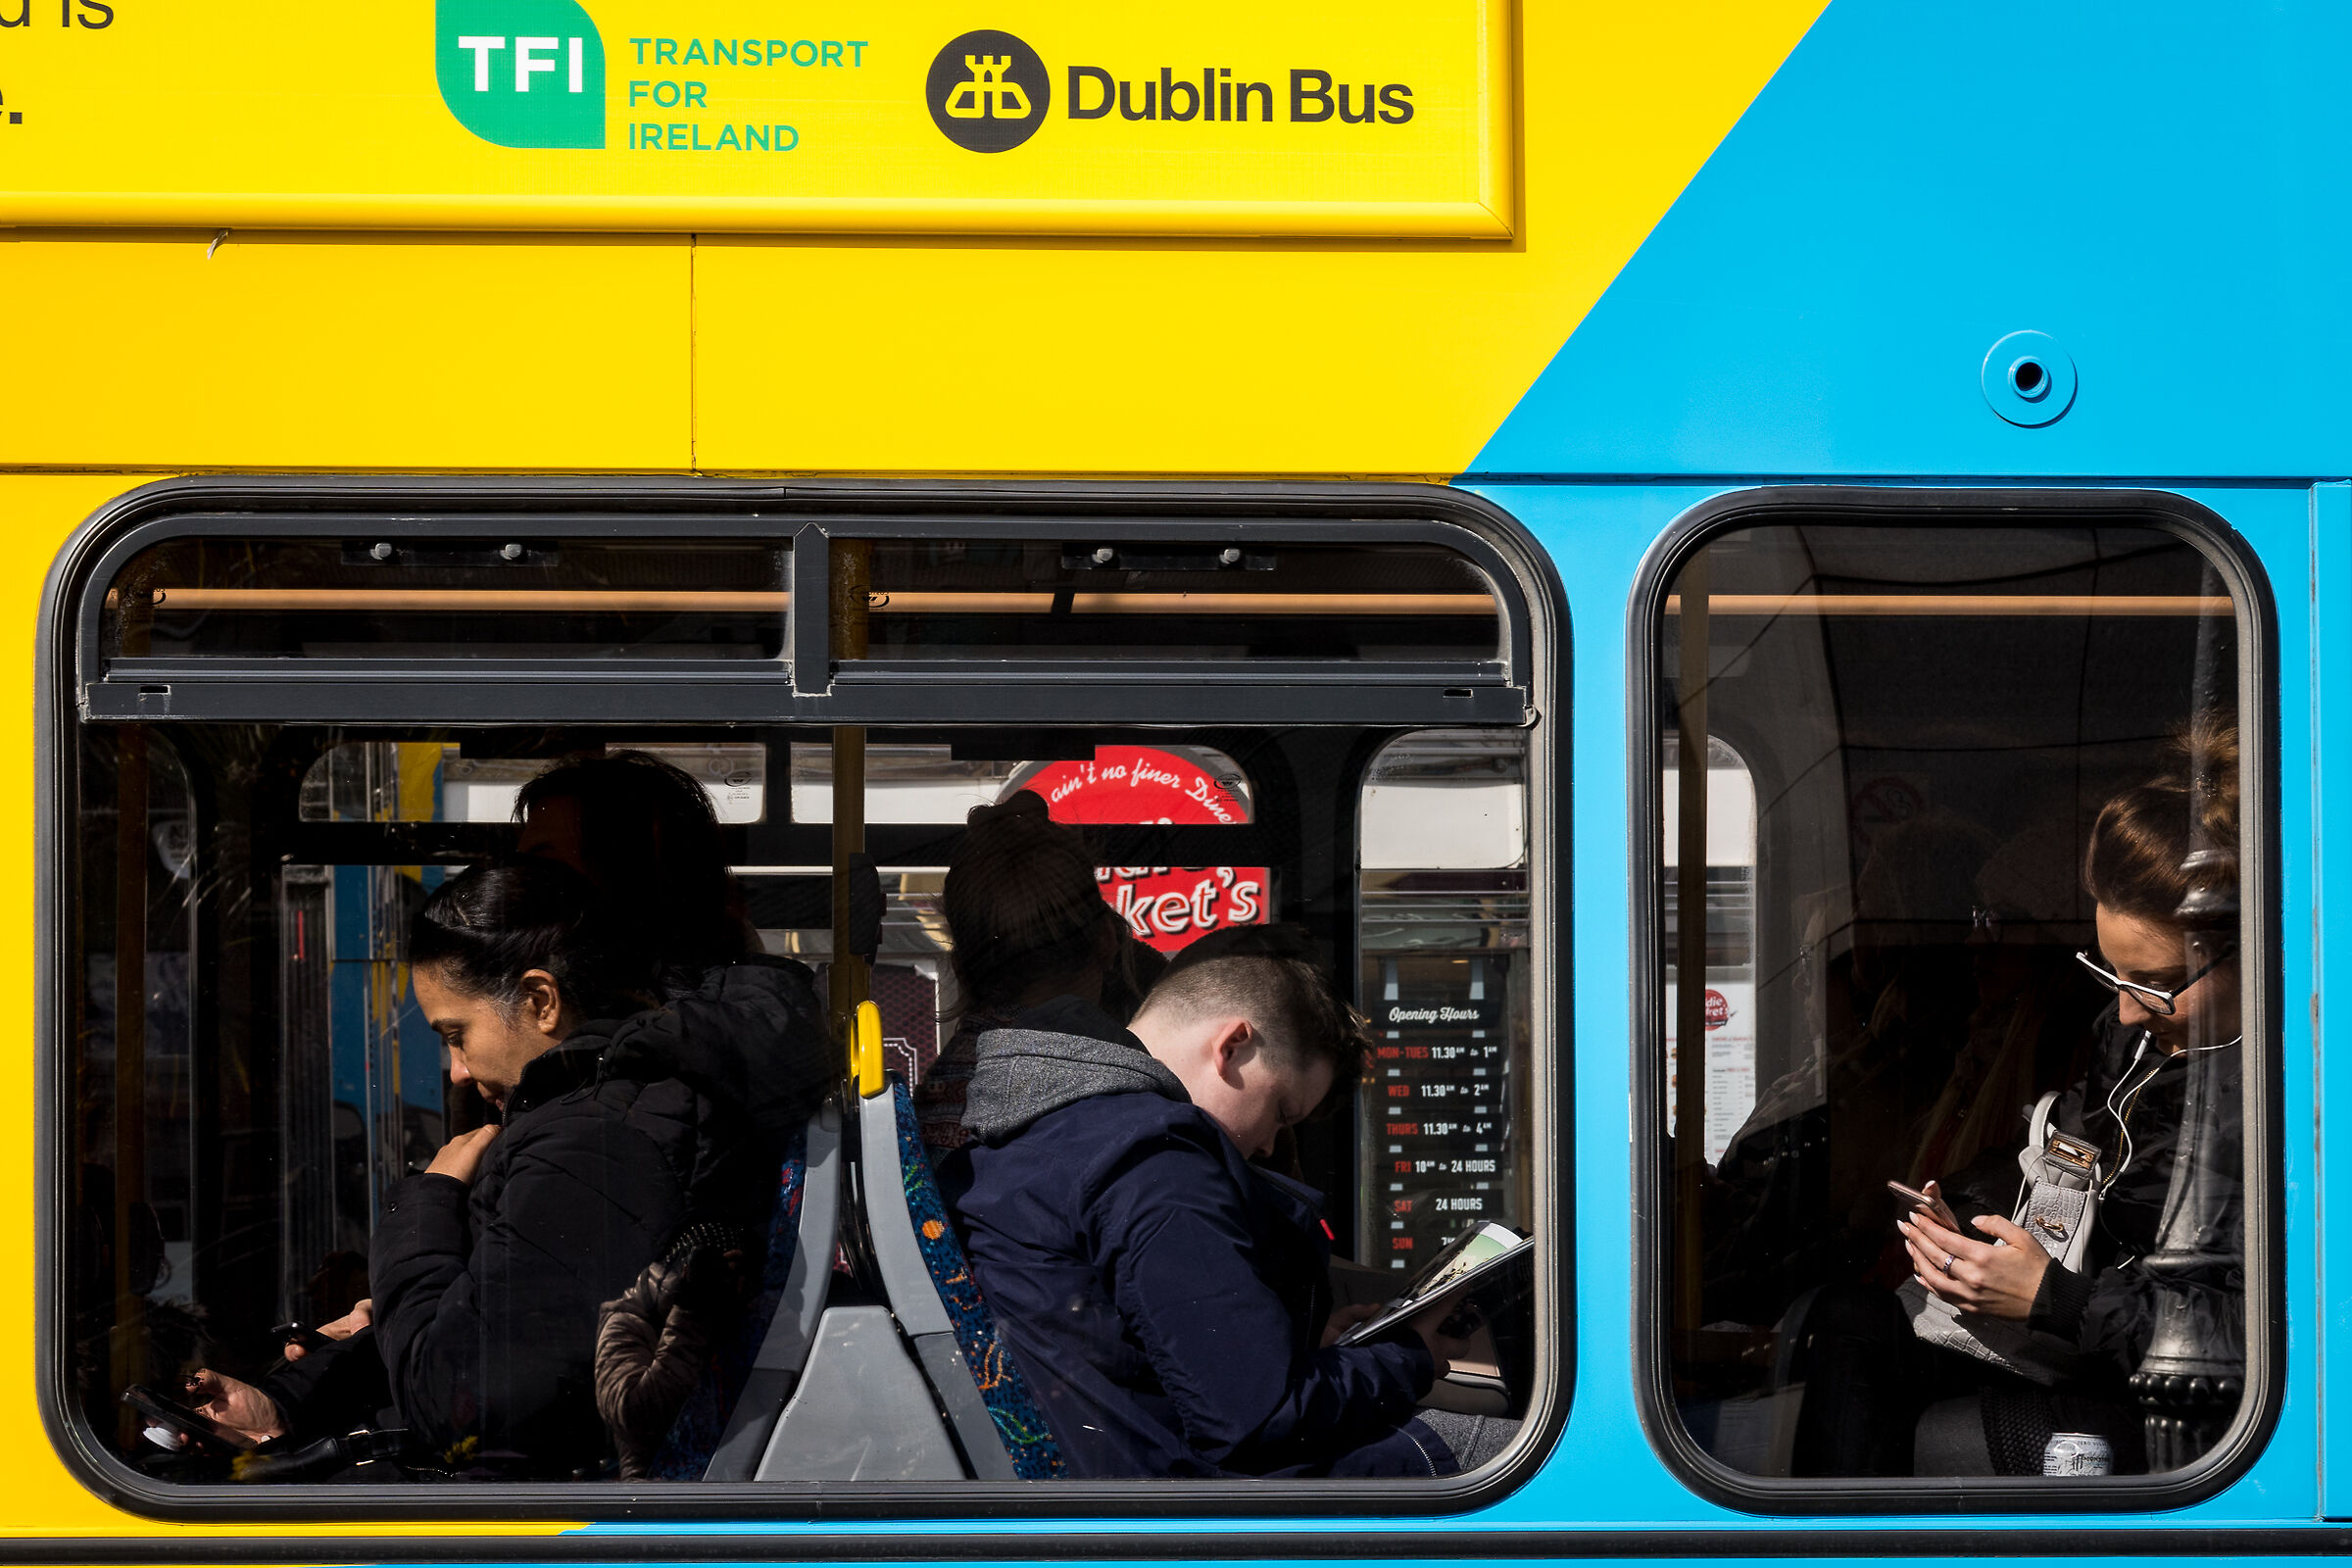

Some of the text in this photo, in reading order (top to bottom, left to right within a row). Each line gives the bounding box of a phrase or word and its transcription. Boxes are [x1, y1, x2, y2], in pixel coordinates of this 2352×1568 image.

[458, 36, 583, 93] TFI
[629, 38, 869, 68] TRANSPORT
[629, 80, 708, 109] FOR
[1067, 65, 1414, 125] Dublin Bus
[629, 123, 800, 152] IRELAND
[1051, 761, 1097, 803] ain't
[1102, 764, 1127, 780] no
[1130, 758, 1181, 788] finer
[1185, 776, 1238, 824] Dine
[1115, 866, 1260, 937] ket's
[1389, 1005, 1480, 1024] Opening Hours
[1377, 1046, 1430, 1059] MON-TUES
[1388, 1085, 1410, 1097] WED
[1386, 1123, 1418, 1136] THURS
[1395, 1161, 1411, 1173] FRI
[1450, 1160, 1463, 1173] 24
[1465, 1159, 1496, 1172] HOURS
[1394, 1198, 1483, 1212] SAT 24 HOURS
[1393, 1237, 1413, 1250] SUN
